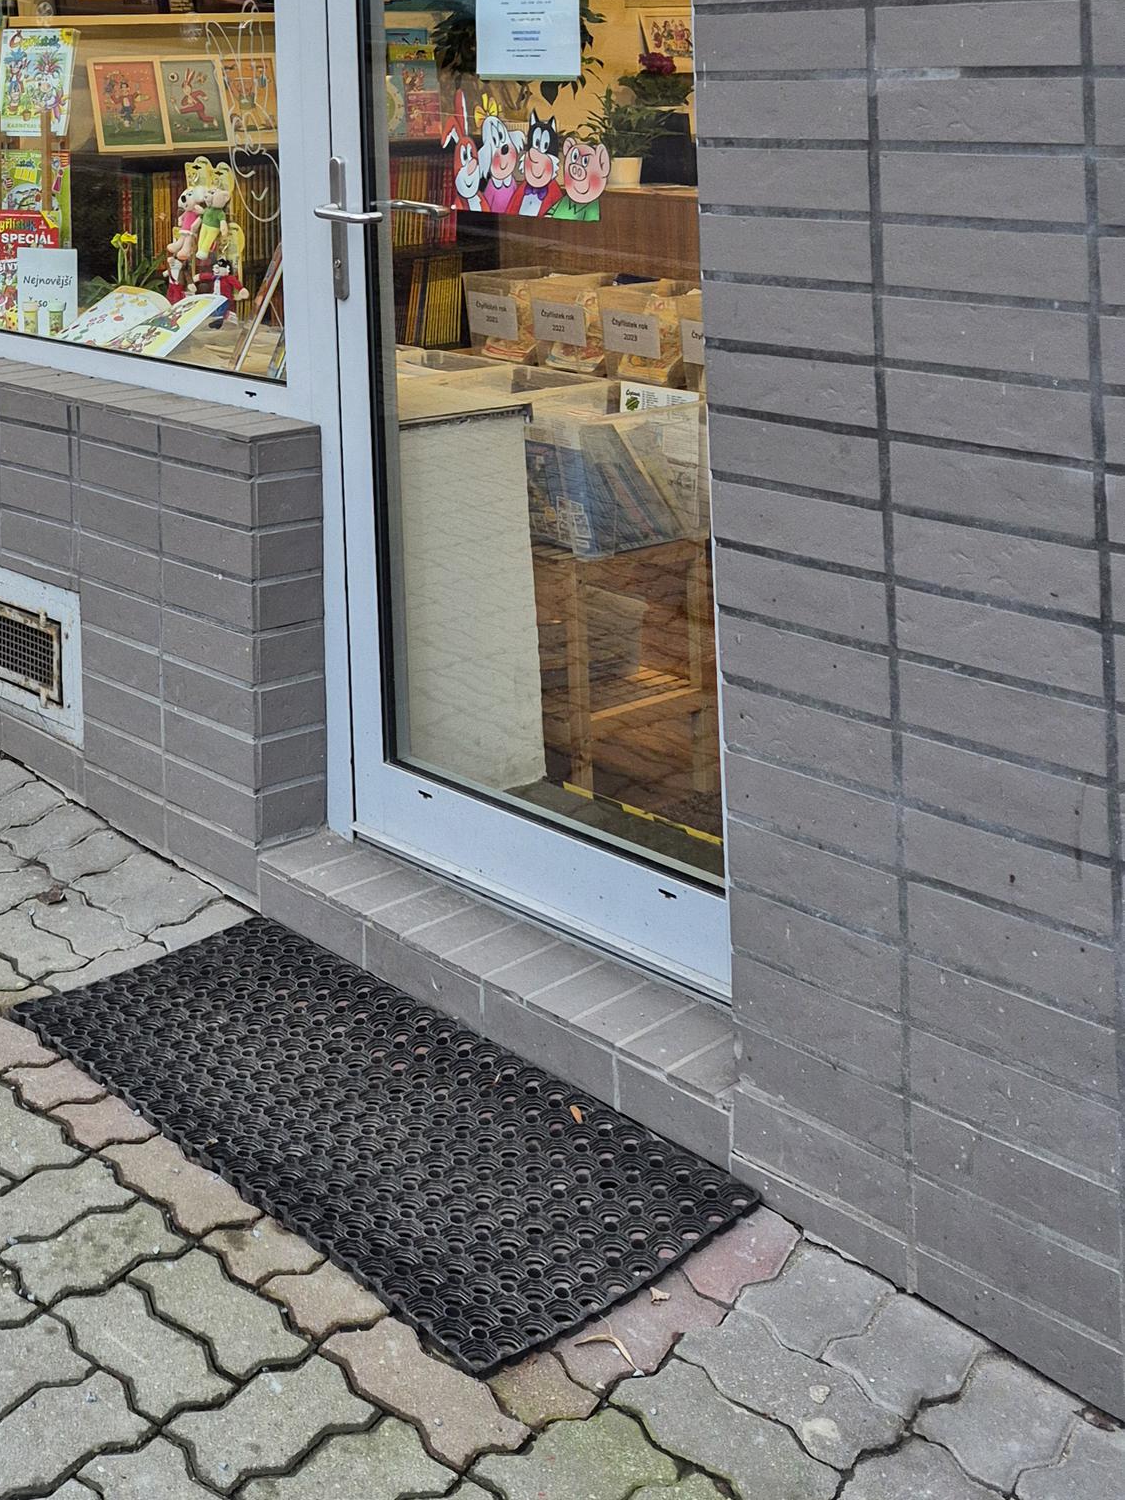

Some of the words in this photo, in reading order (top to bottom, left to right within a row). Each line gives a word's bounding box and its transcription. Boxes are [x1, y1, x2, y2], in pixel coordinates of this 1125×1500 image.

[1, 232, 55, 245] SPECIÁL
[22, 275, 74, 288] Nejnovější
[638, 322, 649, 330] rok
